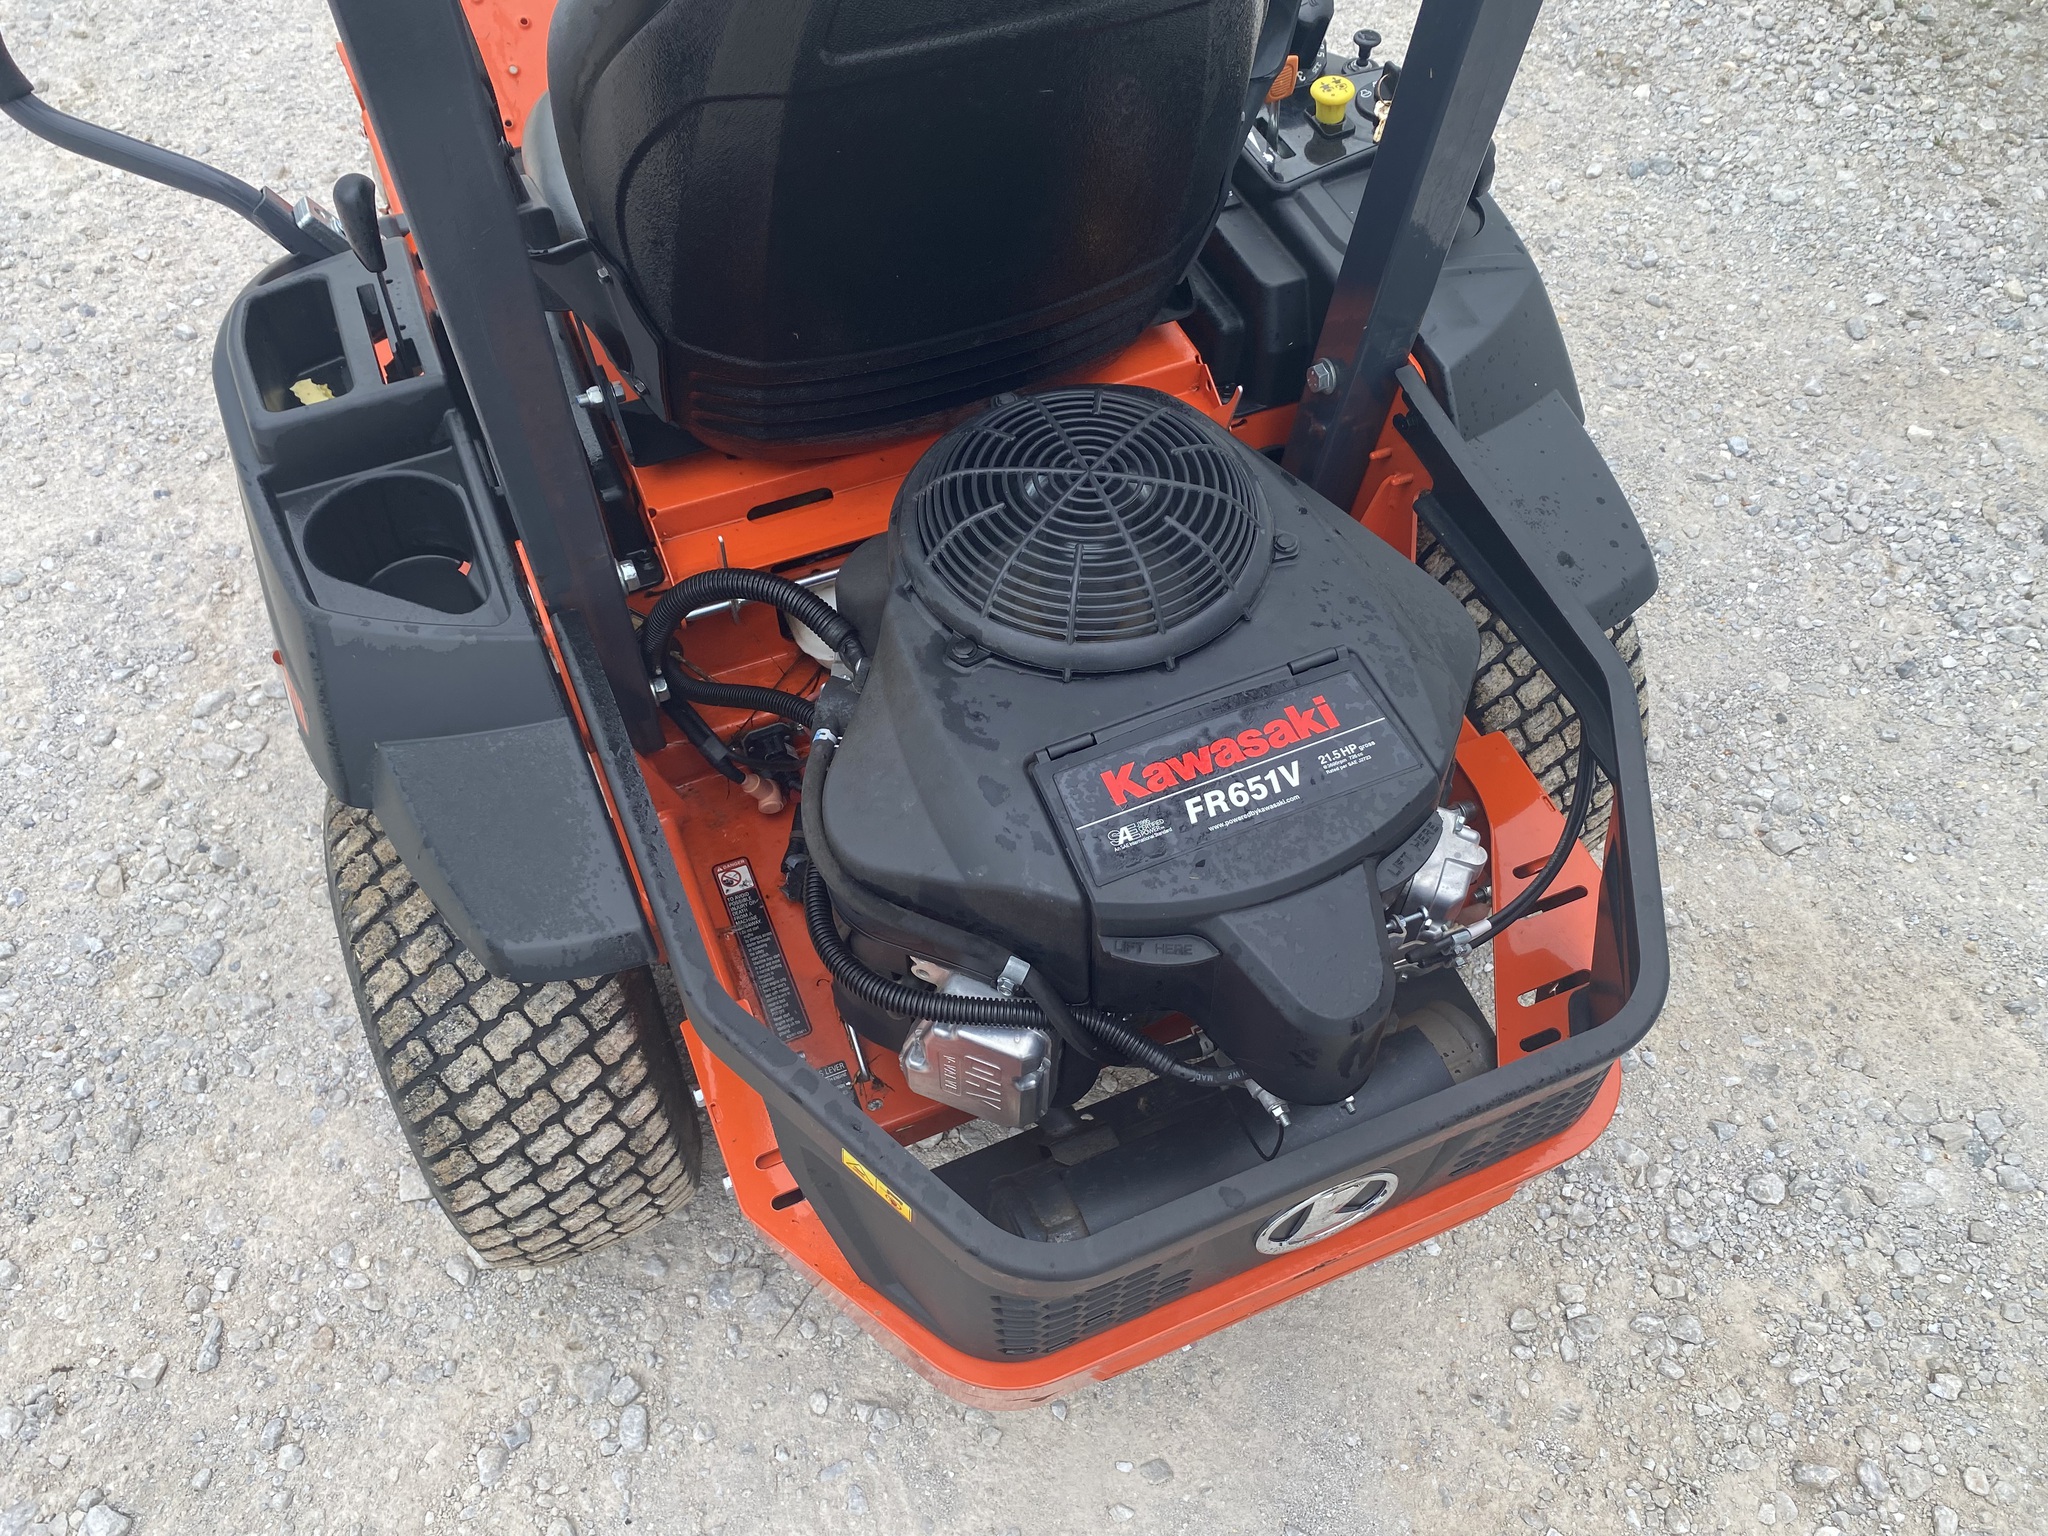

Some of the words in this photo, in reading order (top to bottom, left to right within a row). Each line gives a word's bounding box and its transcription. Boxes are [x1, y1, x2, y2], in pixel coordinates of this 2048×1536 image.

[1100, 695, 1340, 806] Kawasaki
[1318, 750, 1341, 764] 21.5
[1340, 744, 1357, 757] HP
[1358, 741, 1376, 751] gross
[1185, 760, 1300, 824] FR651V
[1208, 795, 1301, 832] www.poweredbykawasaki.com
[1107, 822, 1141, 847] SAE
[1387, 851, 1412, 877] LIFT
[1409, 822, 1439, 852] HERE
[722, 859, 745, 870] DANGER
[1114, 940, 1144, 954] LIFT
[1155, 943, 1193, 955] HERE
[824, 1062, 845, 1075] LEVER
